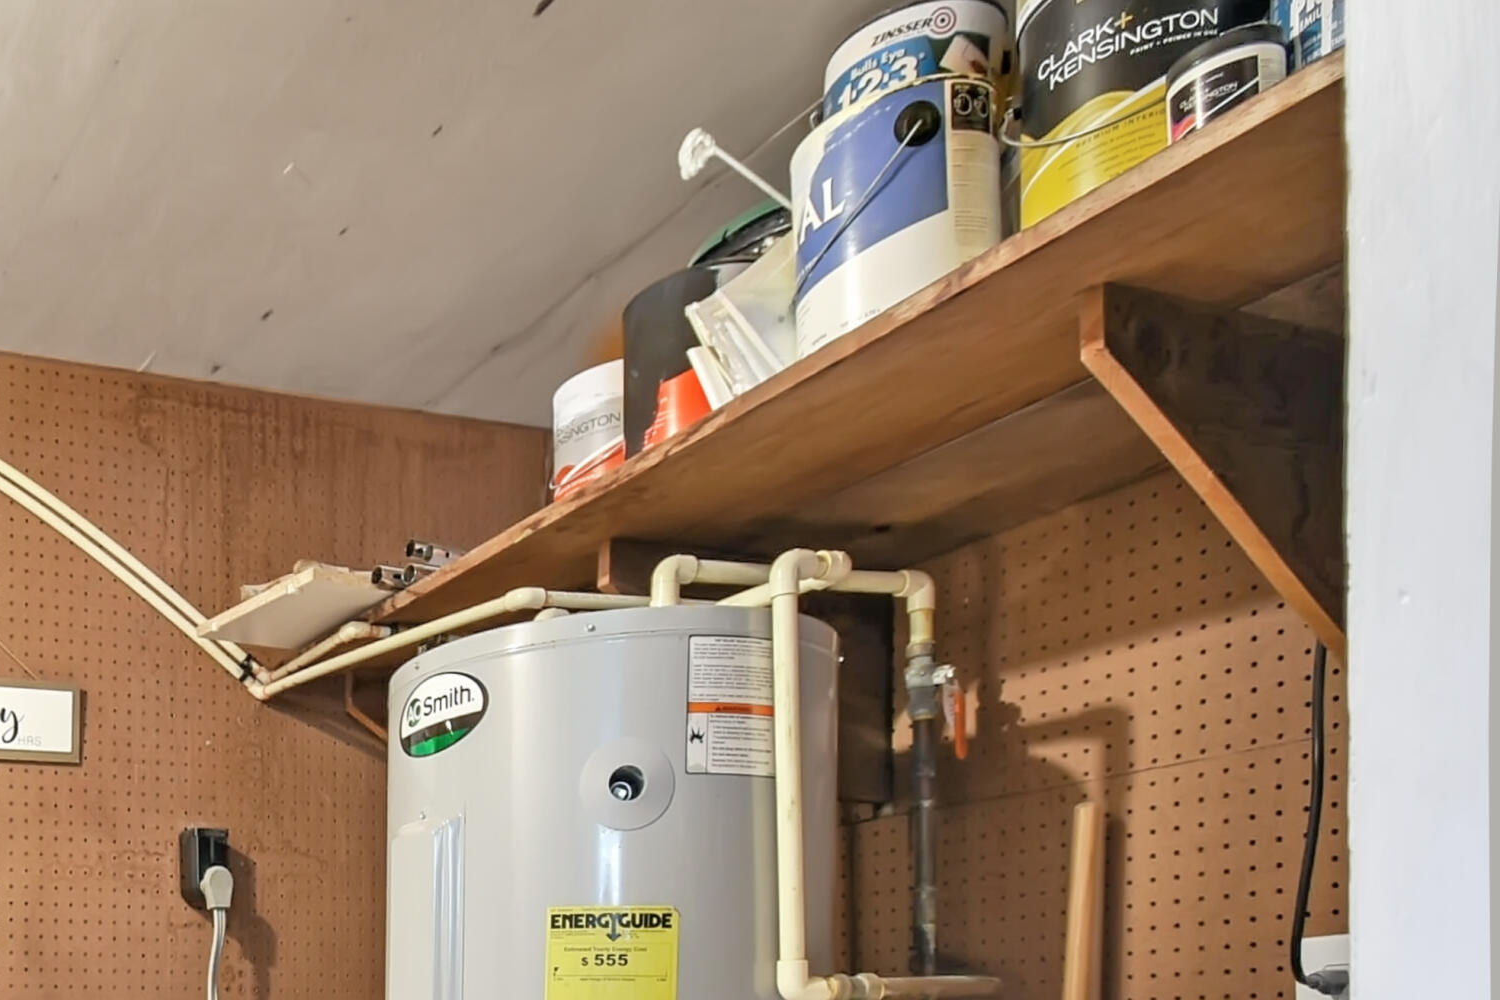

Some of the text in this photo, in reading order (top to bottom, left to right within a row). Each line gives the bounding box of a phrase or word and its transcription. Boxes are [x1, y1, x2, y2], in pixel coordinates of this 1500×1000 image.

[871, 16, 933, 48] ZINSSER
[1049, 7, 1219, 90] KENSINGTON
[423, 685, 472, 717] Smith
[17, 736, 42, 747] HRS
[594, 953, 629, 967] 555
